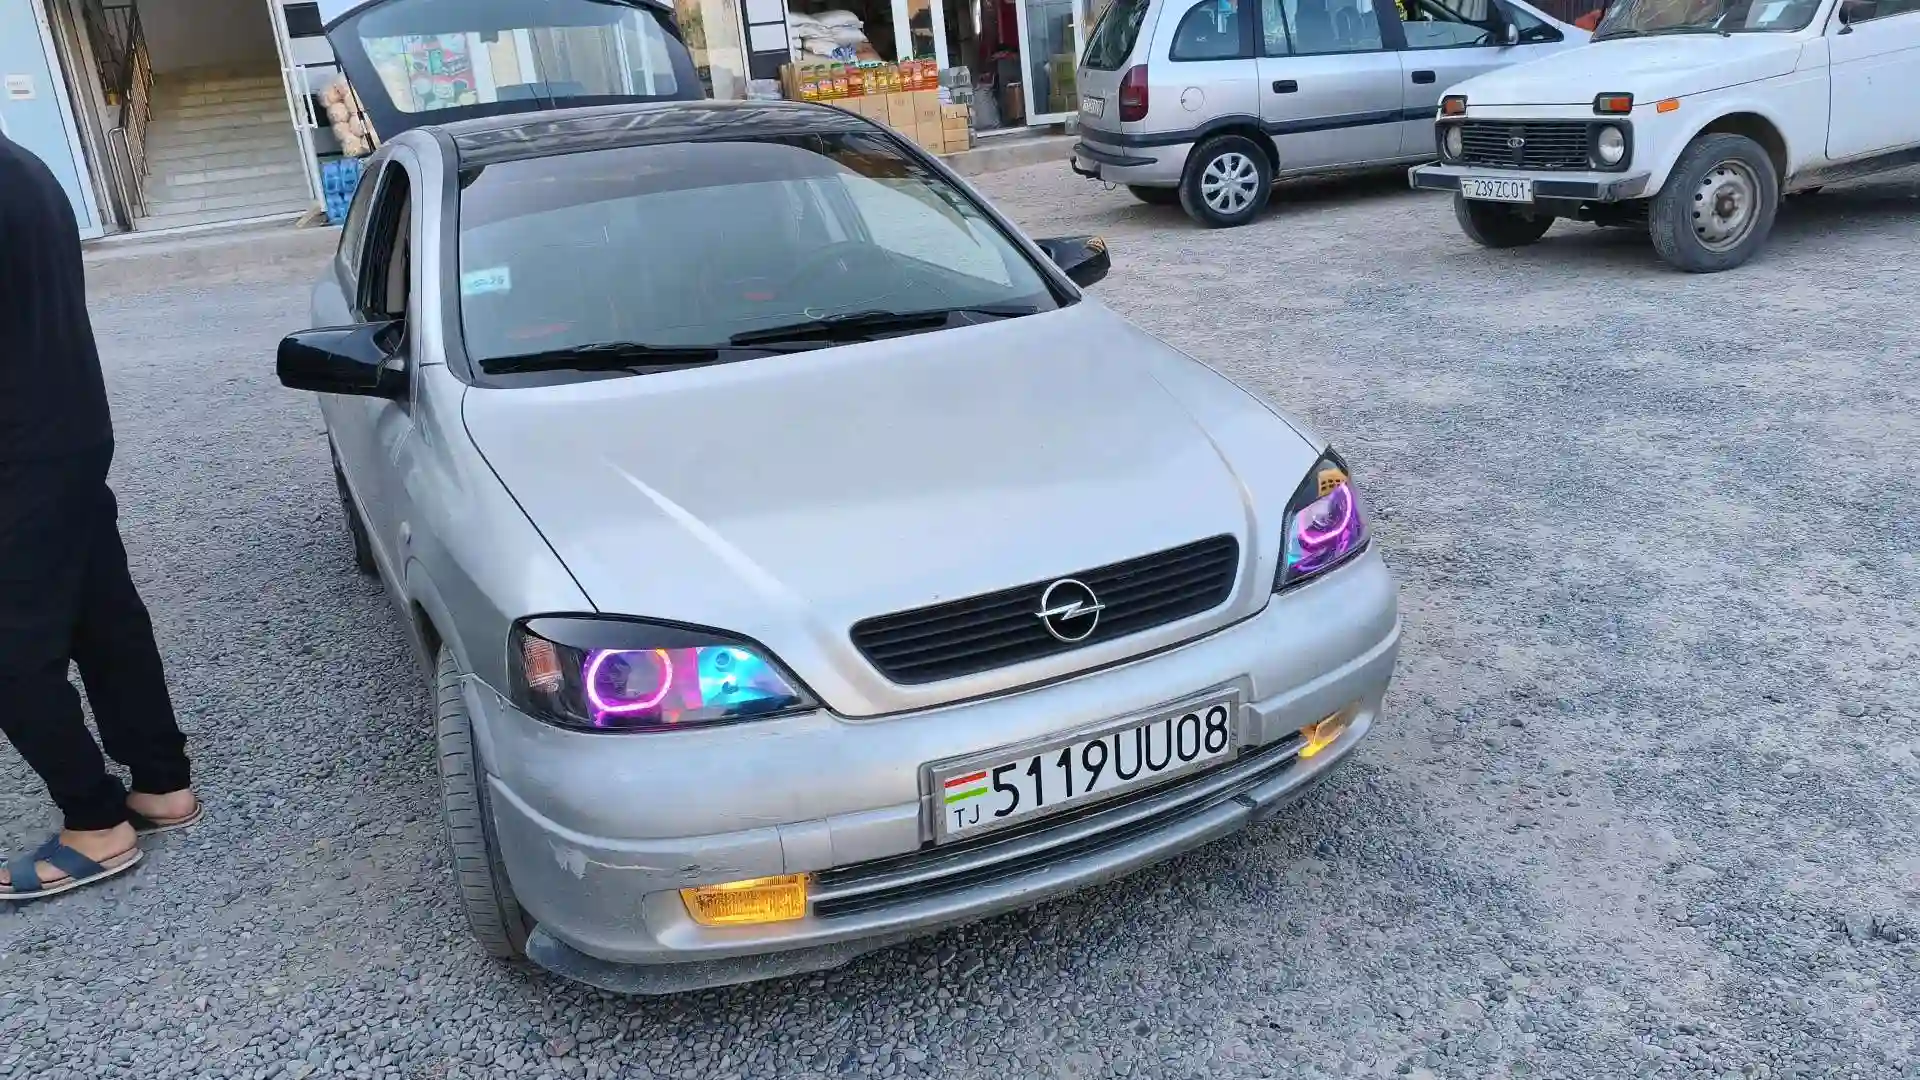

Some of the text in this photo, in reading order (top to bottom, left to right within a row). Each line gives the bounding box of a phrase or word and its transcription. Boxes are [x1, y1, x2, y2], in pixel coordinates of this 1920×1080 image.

[1474, 179, 1525, 200] 239ZC01
[992, 704, 1228, 818] 5119UU08
[953, 804, 980, 828] TJ
